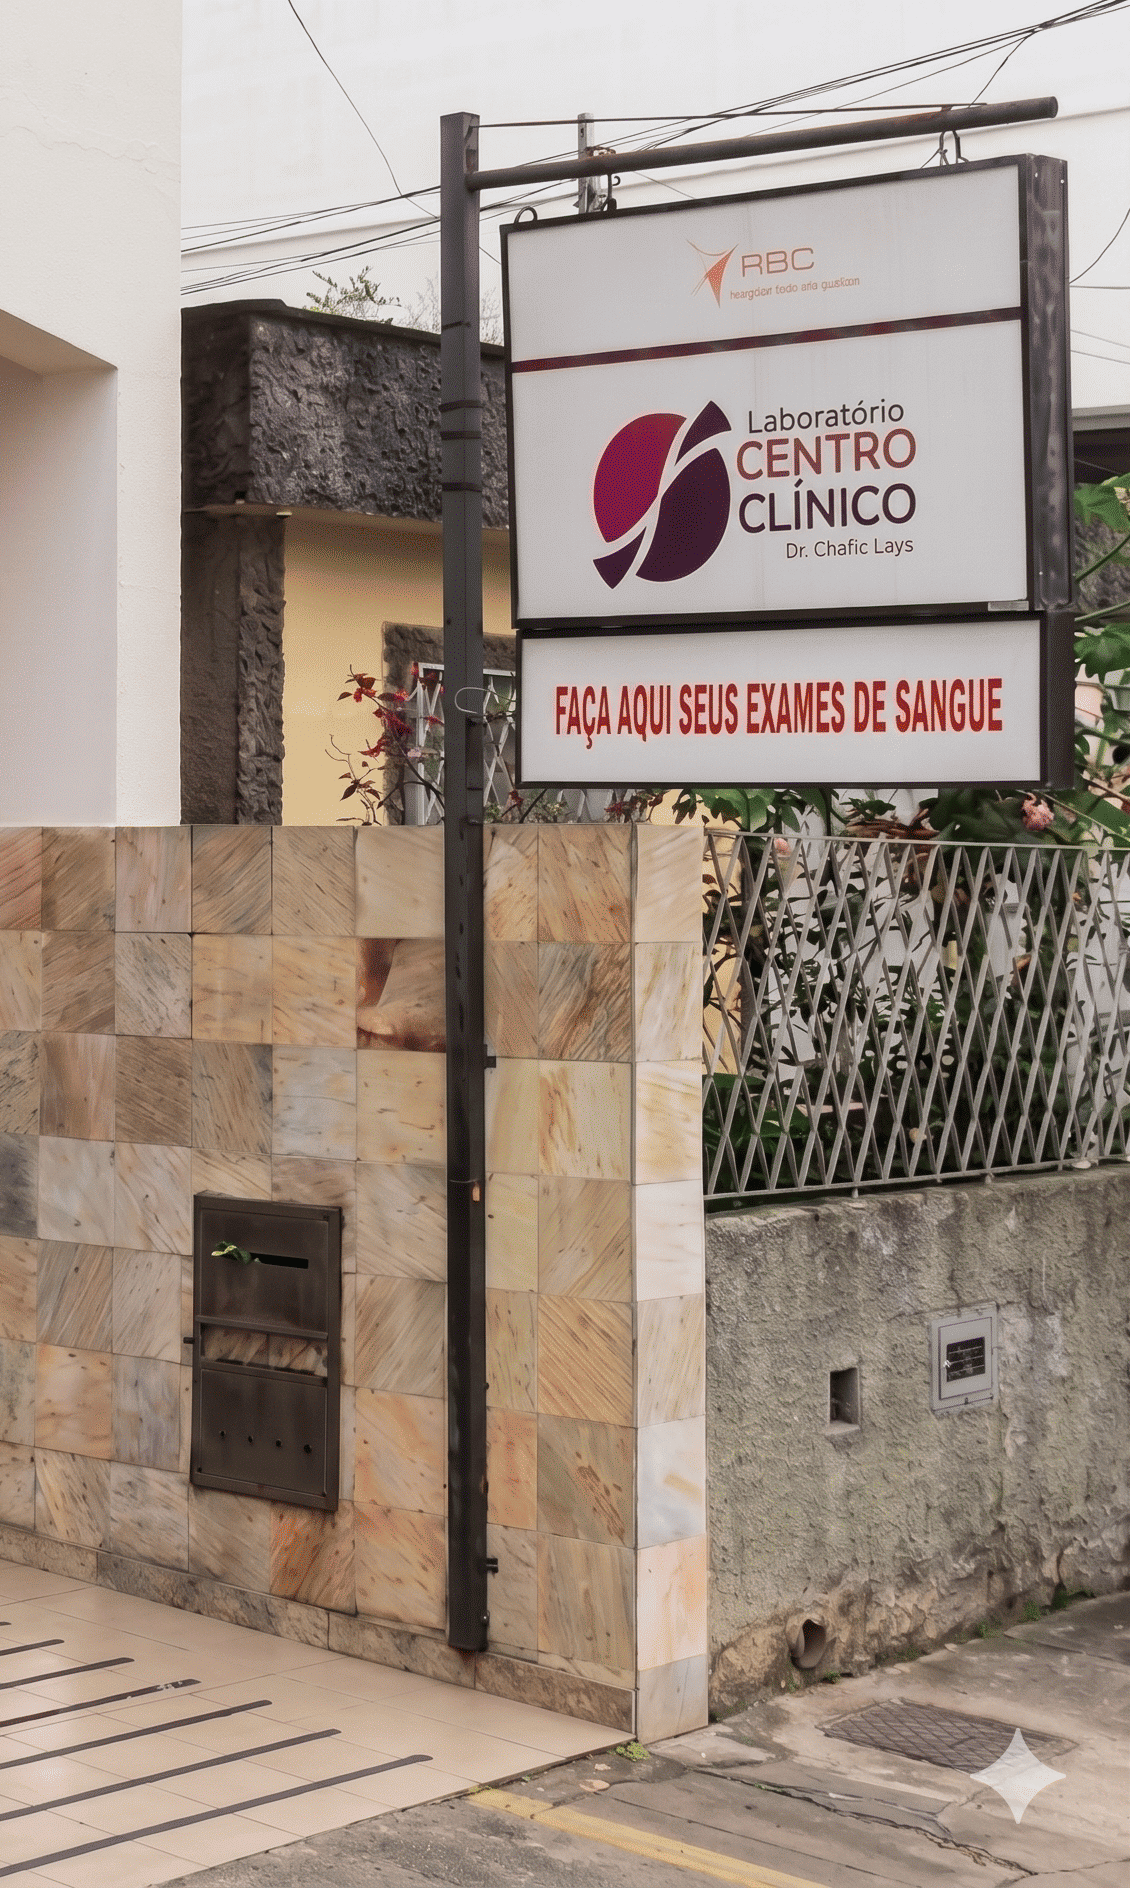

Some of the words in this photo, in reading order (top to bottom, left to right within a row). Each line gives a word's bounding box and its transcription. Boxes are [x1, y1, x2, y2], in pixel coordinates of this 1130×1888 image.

[742, 247, 814, 277] RBC
[748, 399, 904, 434] Laboratório
[737, 428, 917, 481] CENTRO
[738, 479, 917, 534] CLÍNICO
[786, 542, 809, 558] Dr.
[814, 539, 868, 557] Chafic
[874, 538, 914, 557] Lays
[555, 686, 611, 750] FAÇA
[617, 685, 671, 742] AQUI
[679, 684, 738, 736] SEUS
[746, 682, 845, 735] EXAMES
[854, 681, 886, 733] DE
[895, 678, 1003, 733] SANGUE
